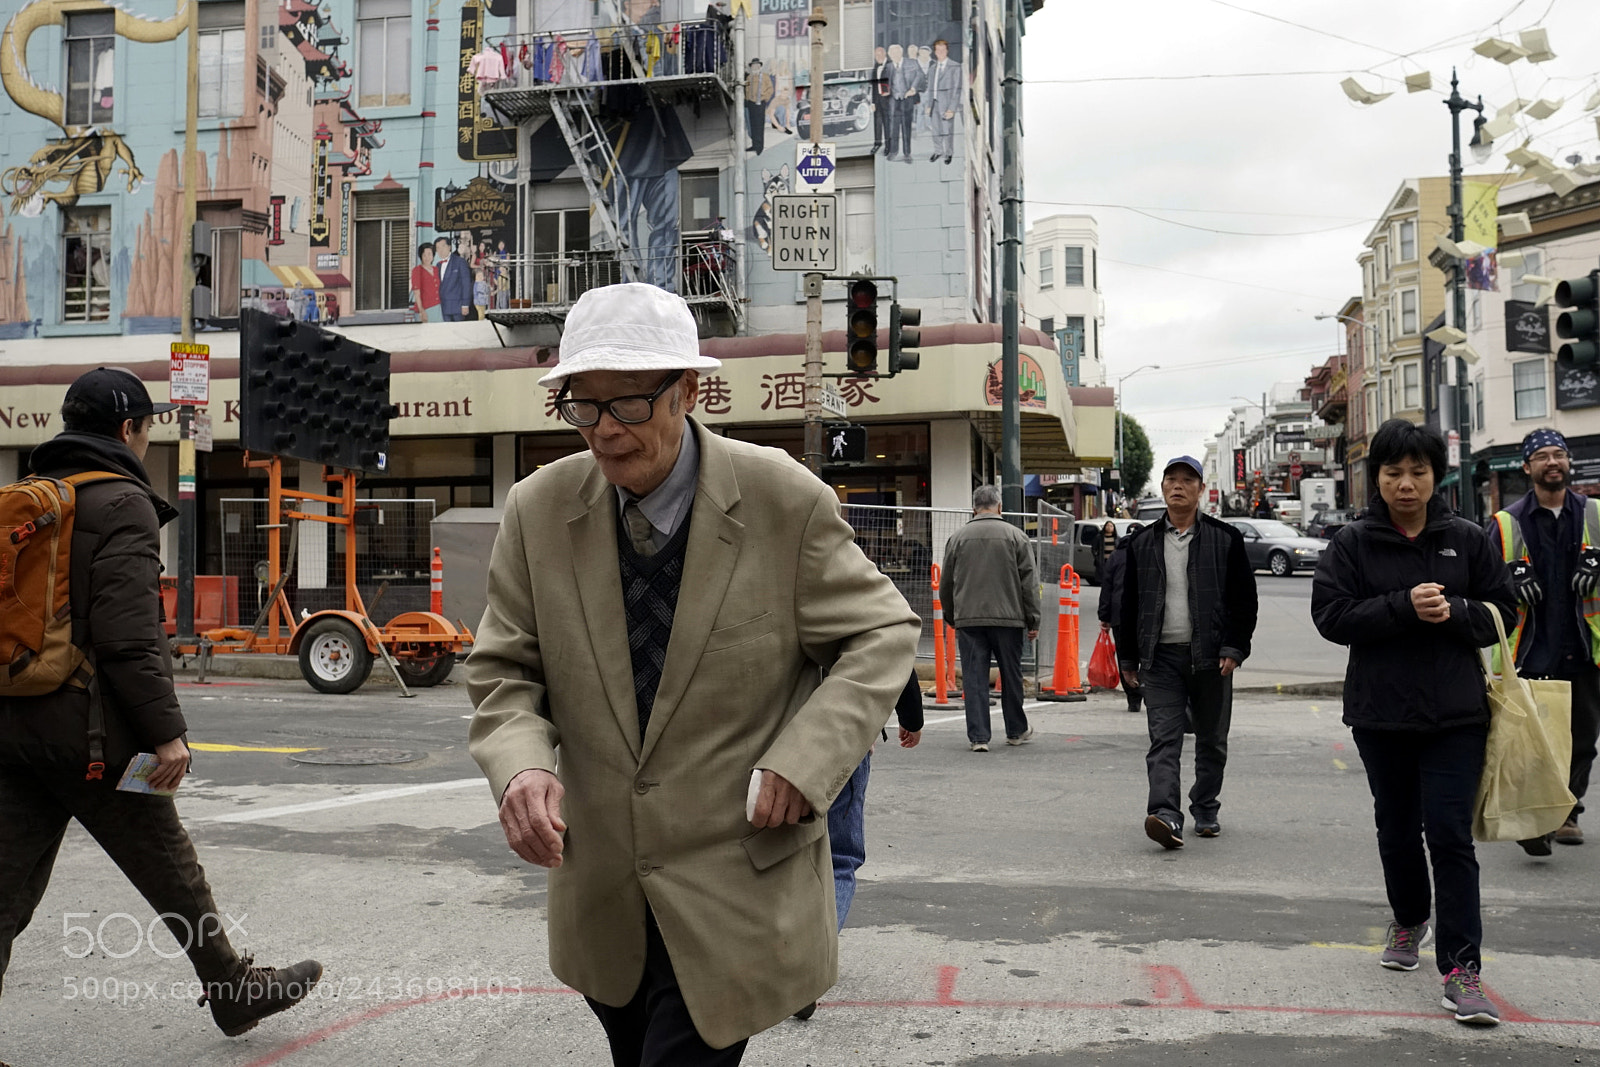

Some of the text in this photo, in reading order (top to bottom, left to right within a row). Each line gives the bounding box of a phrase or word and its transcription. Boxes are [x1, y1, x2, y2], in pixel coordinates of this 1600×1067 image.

[458, 19, 477, 144] 新香港酒家
[810, 158, 822, 167] NO
[802, 168, 829, 177] LITTER
[447, 200, 511, 219] SHANGHAI
[464, 211, 494, 222] LOW
[779, 204, 830, 219] RIGHT
[779, 226, 830, 240] TURN
[780, 247, 829, 262] ONLY
[174, 344, 206, 354] BUS STOP
[171, 359, 183, 370] NO
[1064, 333, 1074, 387] HOT
[821, 391, 844, 413] GRANT
[0, 396, 472, 429] New urant
